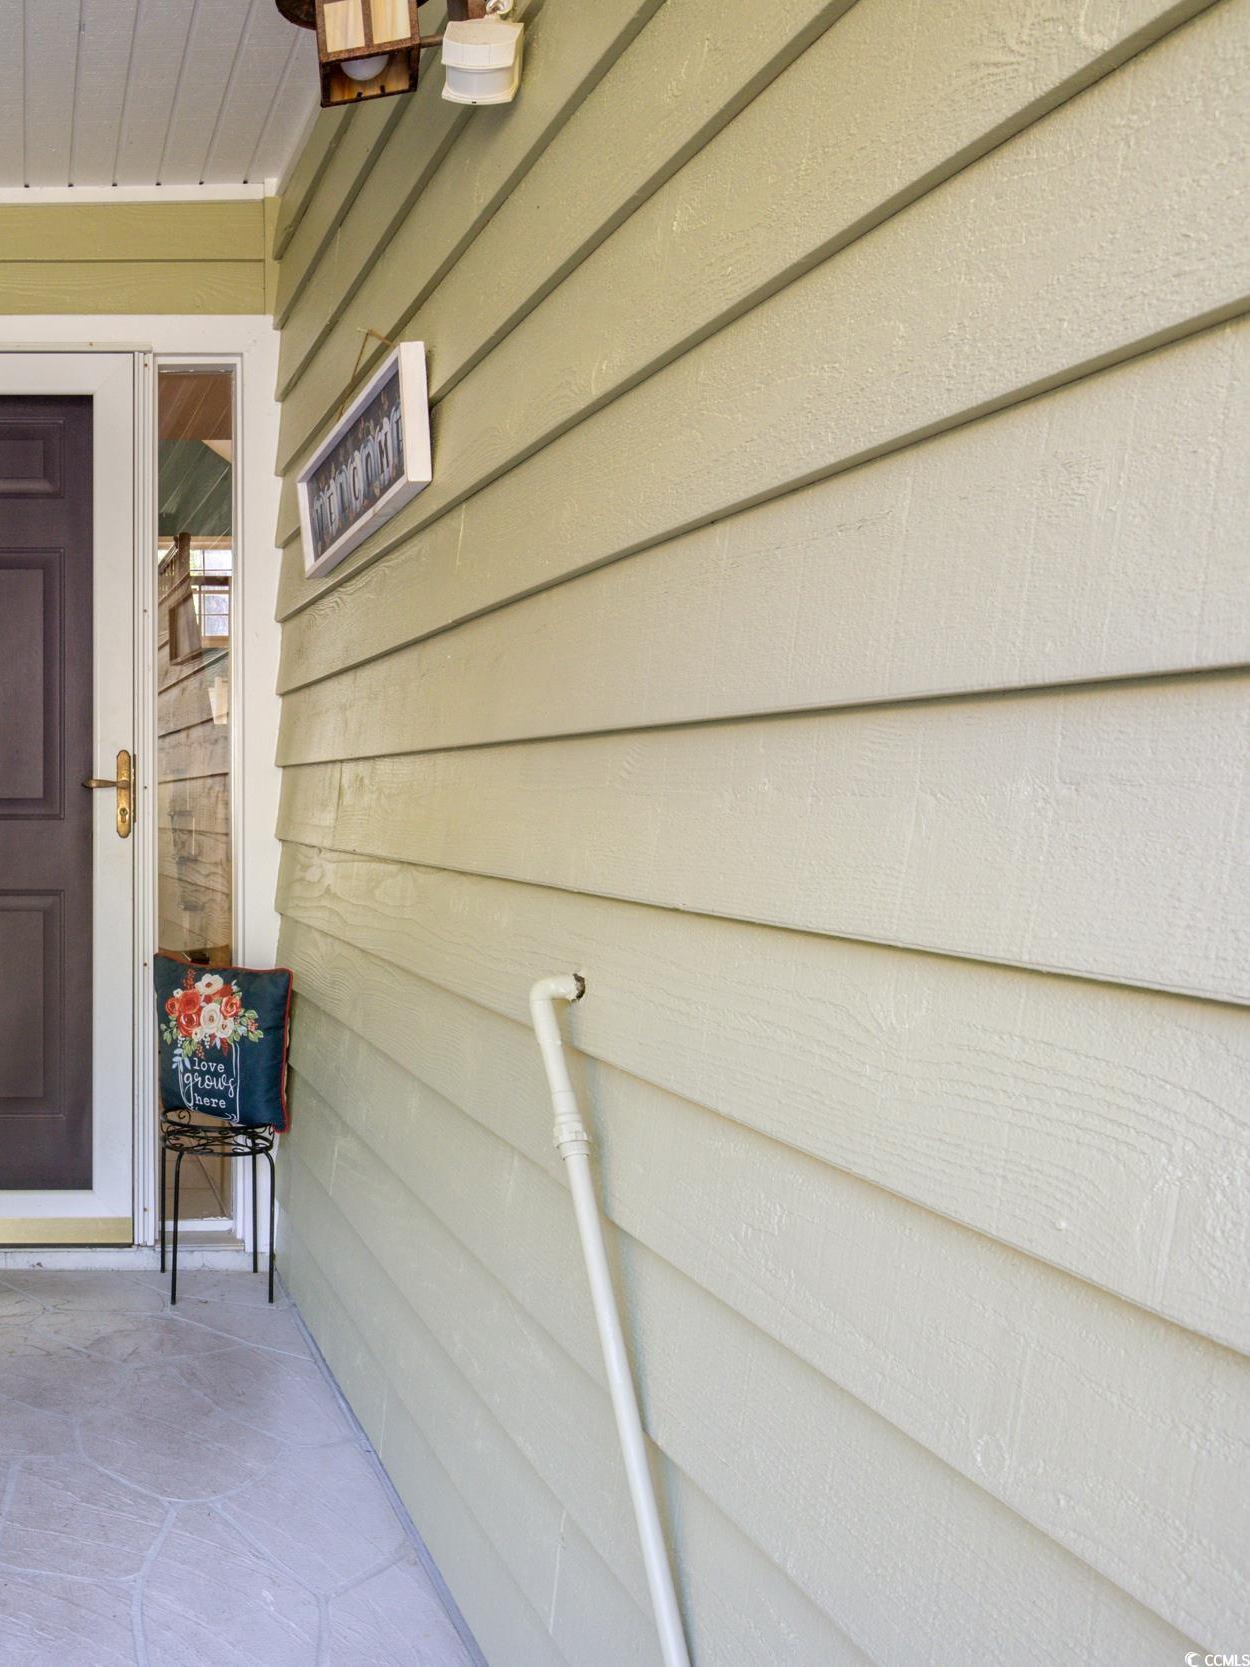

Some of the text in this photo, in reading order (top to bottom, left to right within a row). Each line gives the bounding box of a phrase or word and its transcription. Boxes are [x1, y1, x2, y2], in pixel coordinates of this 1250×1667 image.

[193, 1057, 225, 1073] love
[183, 1072, 237, 1107] grows
[194, 1093, 226, 1109] here
